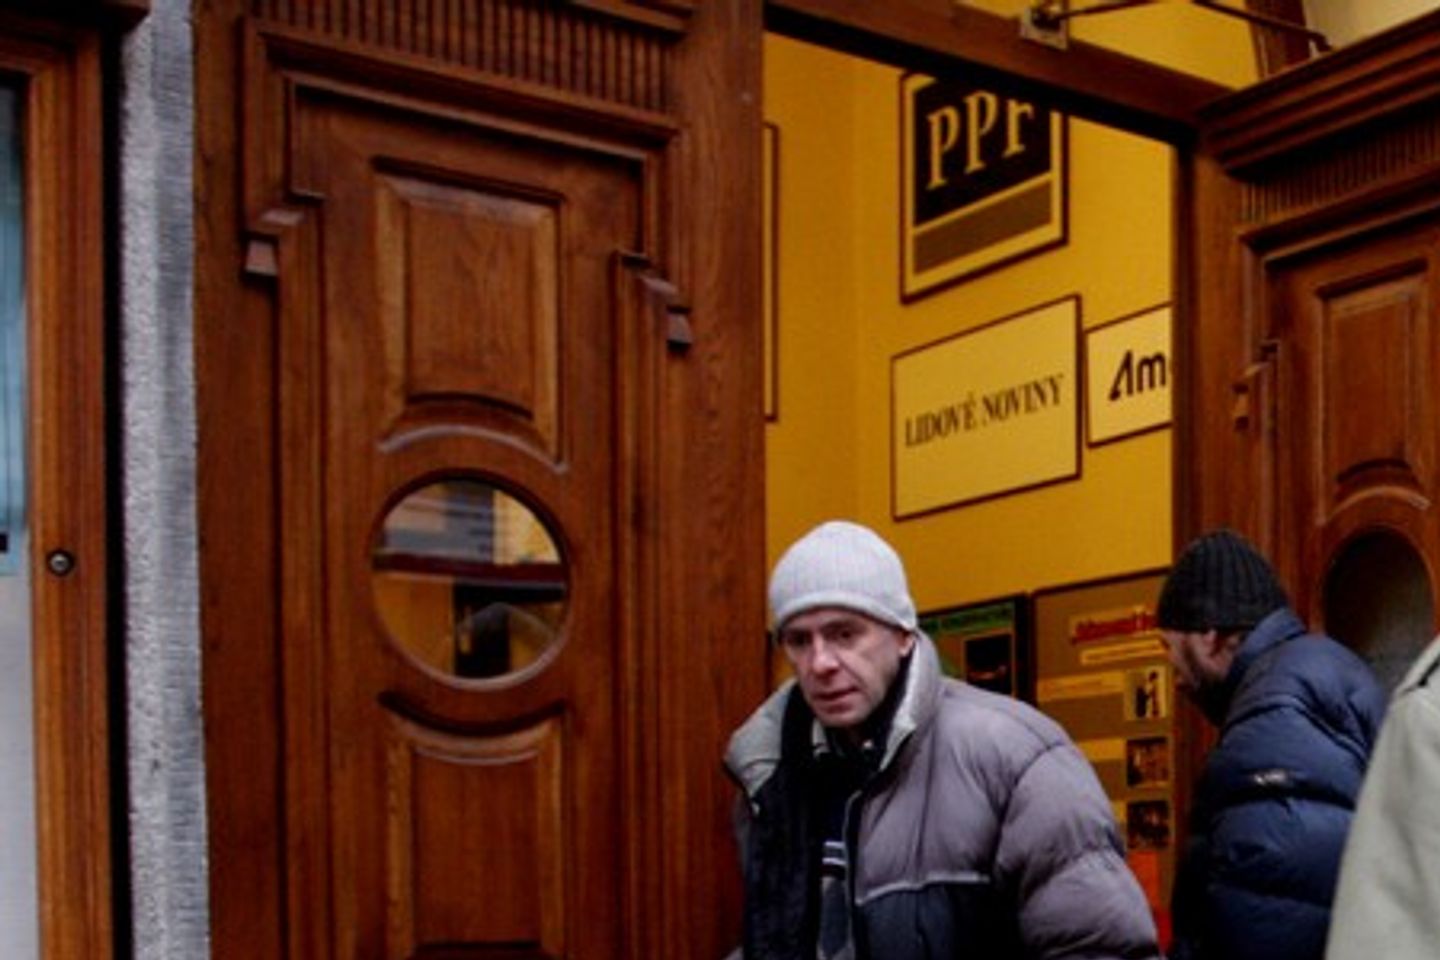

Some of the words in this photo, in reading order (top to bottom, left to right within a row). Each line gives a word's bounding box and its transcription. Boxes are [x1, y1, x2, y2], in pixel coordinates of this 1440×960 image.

[1107, 350, 1171, 401] Am
[904, 389, 977, 448] LIDOVÉ
[981, 373, 1065, 426] NOVINY
